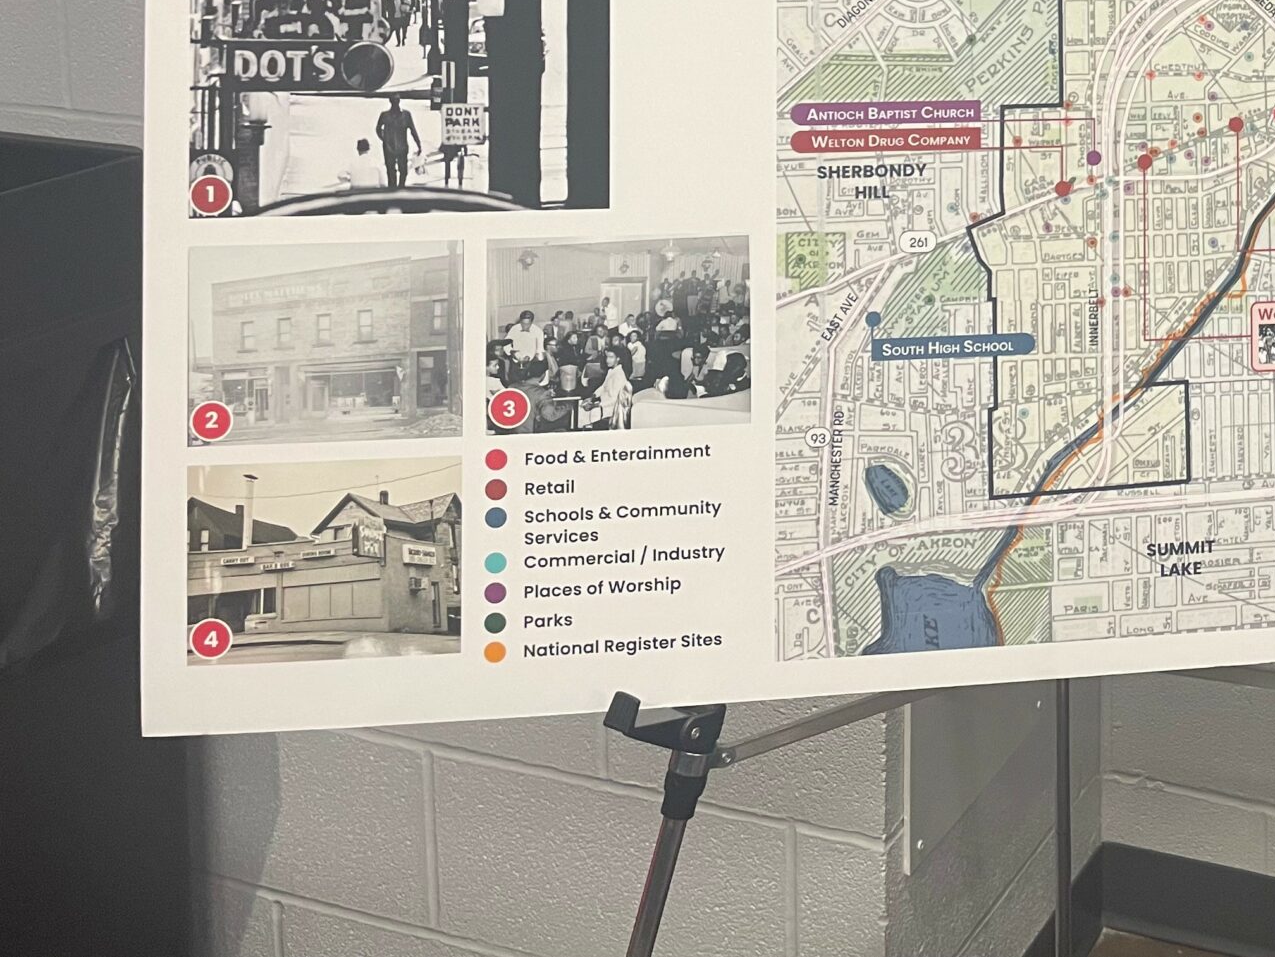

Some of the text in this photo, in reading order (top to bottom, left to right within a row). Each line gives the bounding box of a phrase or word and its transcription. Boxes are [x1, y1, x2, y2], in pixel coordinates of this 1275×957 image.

[234, 46, 335, 82] DOT'S
[445, 107, 479, 117] DONT
[445, 118, 480, 128] PARK
[817, 163, 927, 179] SHERBONDY
[206, 186, 215, 203] 1
[855, 186, 890, 199] HILL
[910, 237, 928, 248] 261
[821, 293, 859, 342] EAST AVE
[1088, 288, 1099, 347] INNERBELT
[503, 400, 515, 417] 3
[205, 411, 218, 428] 2
[811, 433, 826, 444] 93
[525, 444, 711, 465] Food & Enterainment
[828, 429, 843, 506] MANCHESTER
[525, 480, 575, 495] Retail
[525, 500, 722, 522] Schools & Community
[525, 529, 599, 545] Services
[524, 545, 725, 568] Commercial / Industry
[1147, 540, 1214, 557] SUMMIT
[1160, 561, 1202, 577] LAKE
[524, 577, 682, 598] Places of Worship
[524, 614, 573, 628] Parks
[204, 631, 218, 647] 4
[524, 633, 722, 657] National Register Sites
